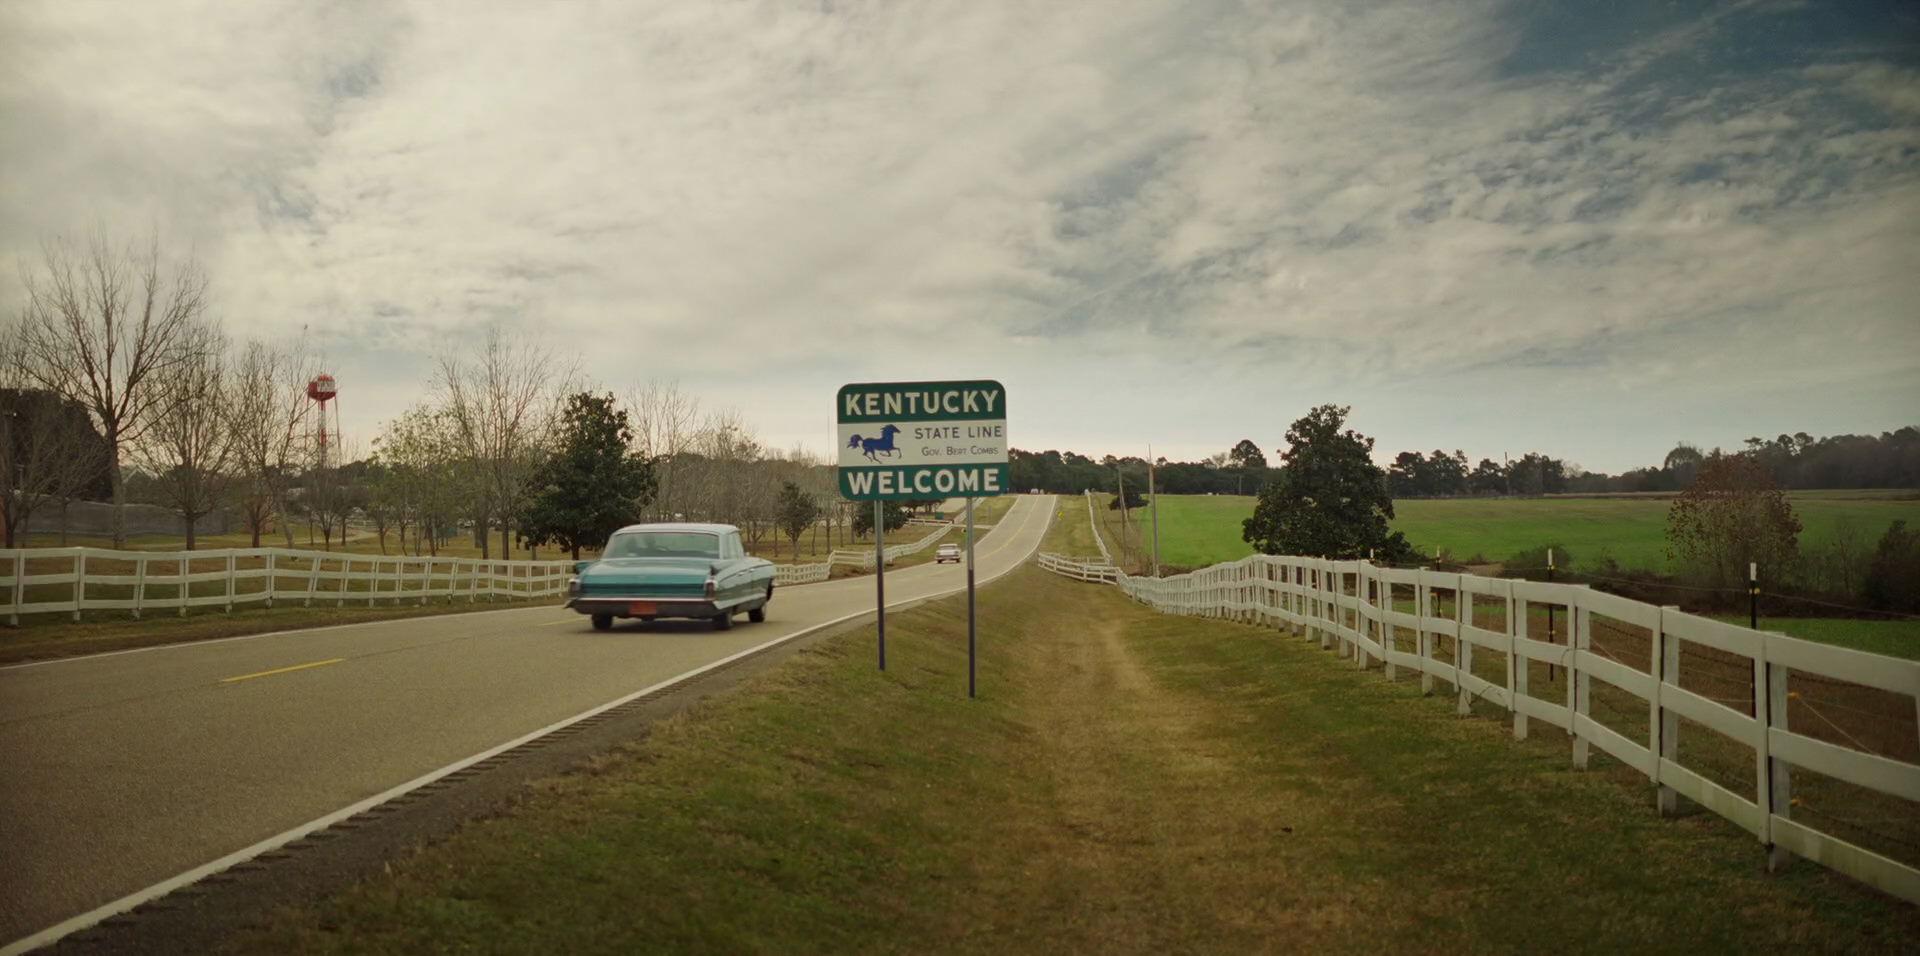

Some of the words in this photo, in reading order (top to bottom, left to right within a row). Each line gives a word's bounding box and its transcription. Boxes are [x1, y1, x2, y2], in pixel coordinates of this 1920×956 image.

[845, 390, 998, 416] KENTUCKY
[914, 426, 960, 440] STATE
[967, 425, 1002, 438] LINE
[847, 468, 1000, 495] WELCOME
